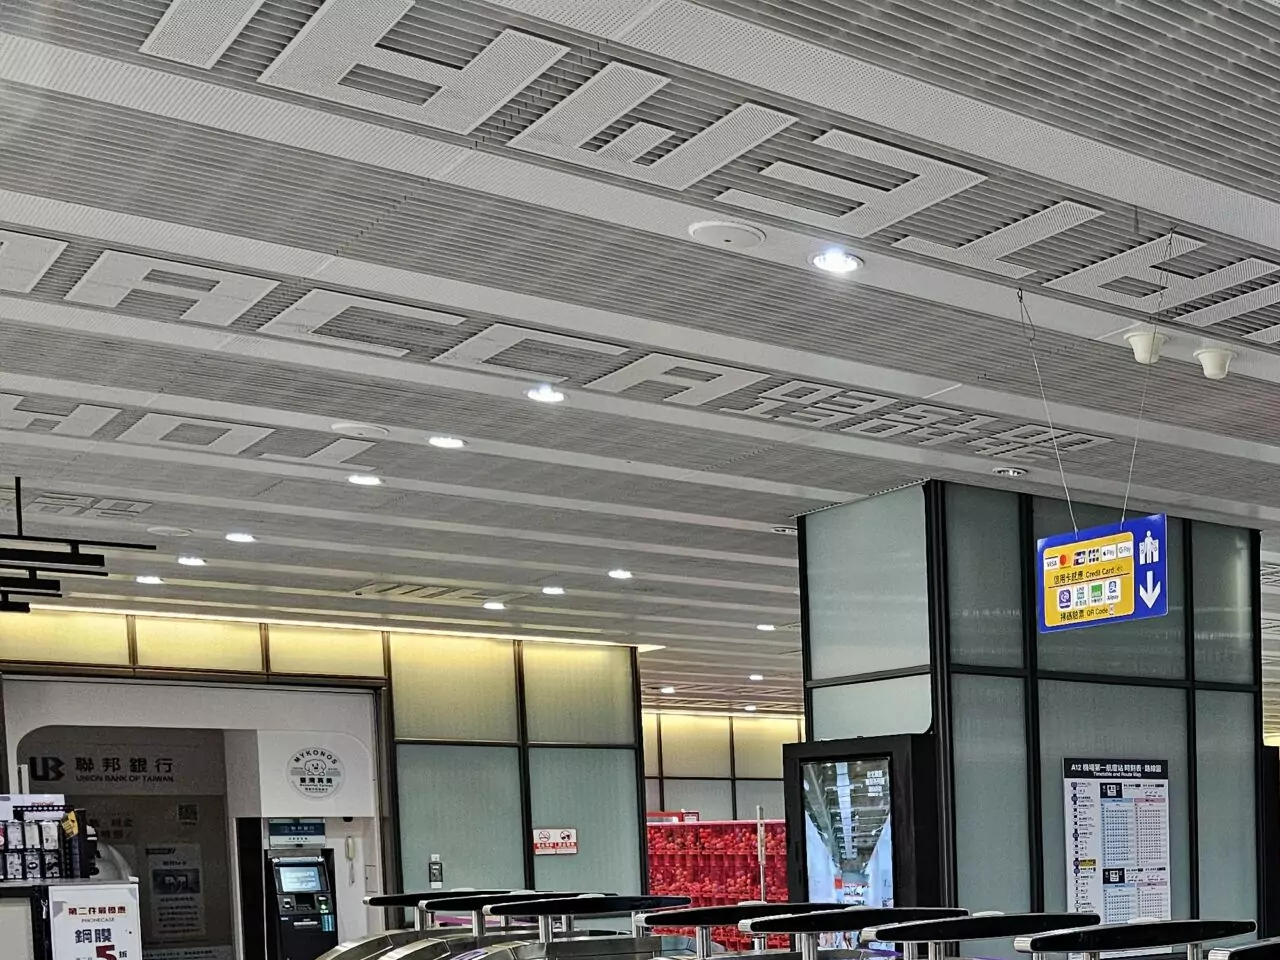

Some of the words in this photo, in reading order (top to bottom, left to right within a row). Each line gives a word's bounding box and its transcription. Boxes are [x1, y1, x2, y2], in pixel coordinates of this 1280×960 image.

[1085, 570, 1100, 578] Credit
[1102, 567, 1114, 575] Card
[1096, 607, 1108, 615] Code
[294, 749, 338, 765] MYKONOS
[75, 757, 173, 773] 聯邦銀行
[142, 775, 173, 783] TAIWAN
[74, 928, 112, 944] 鋼膜
